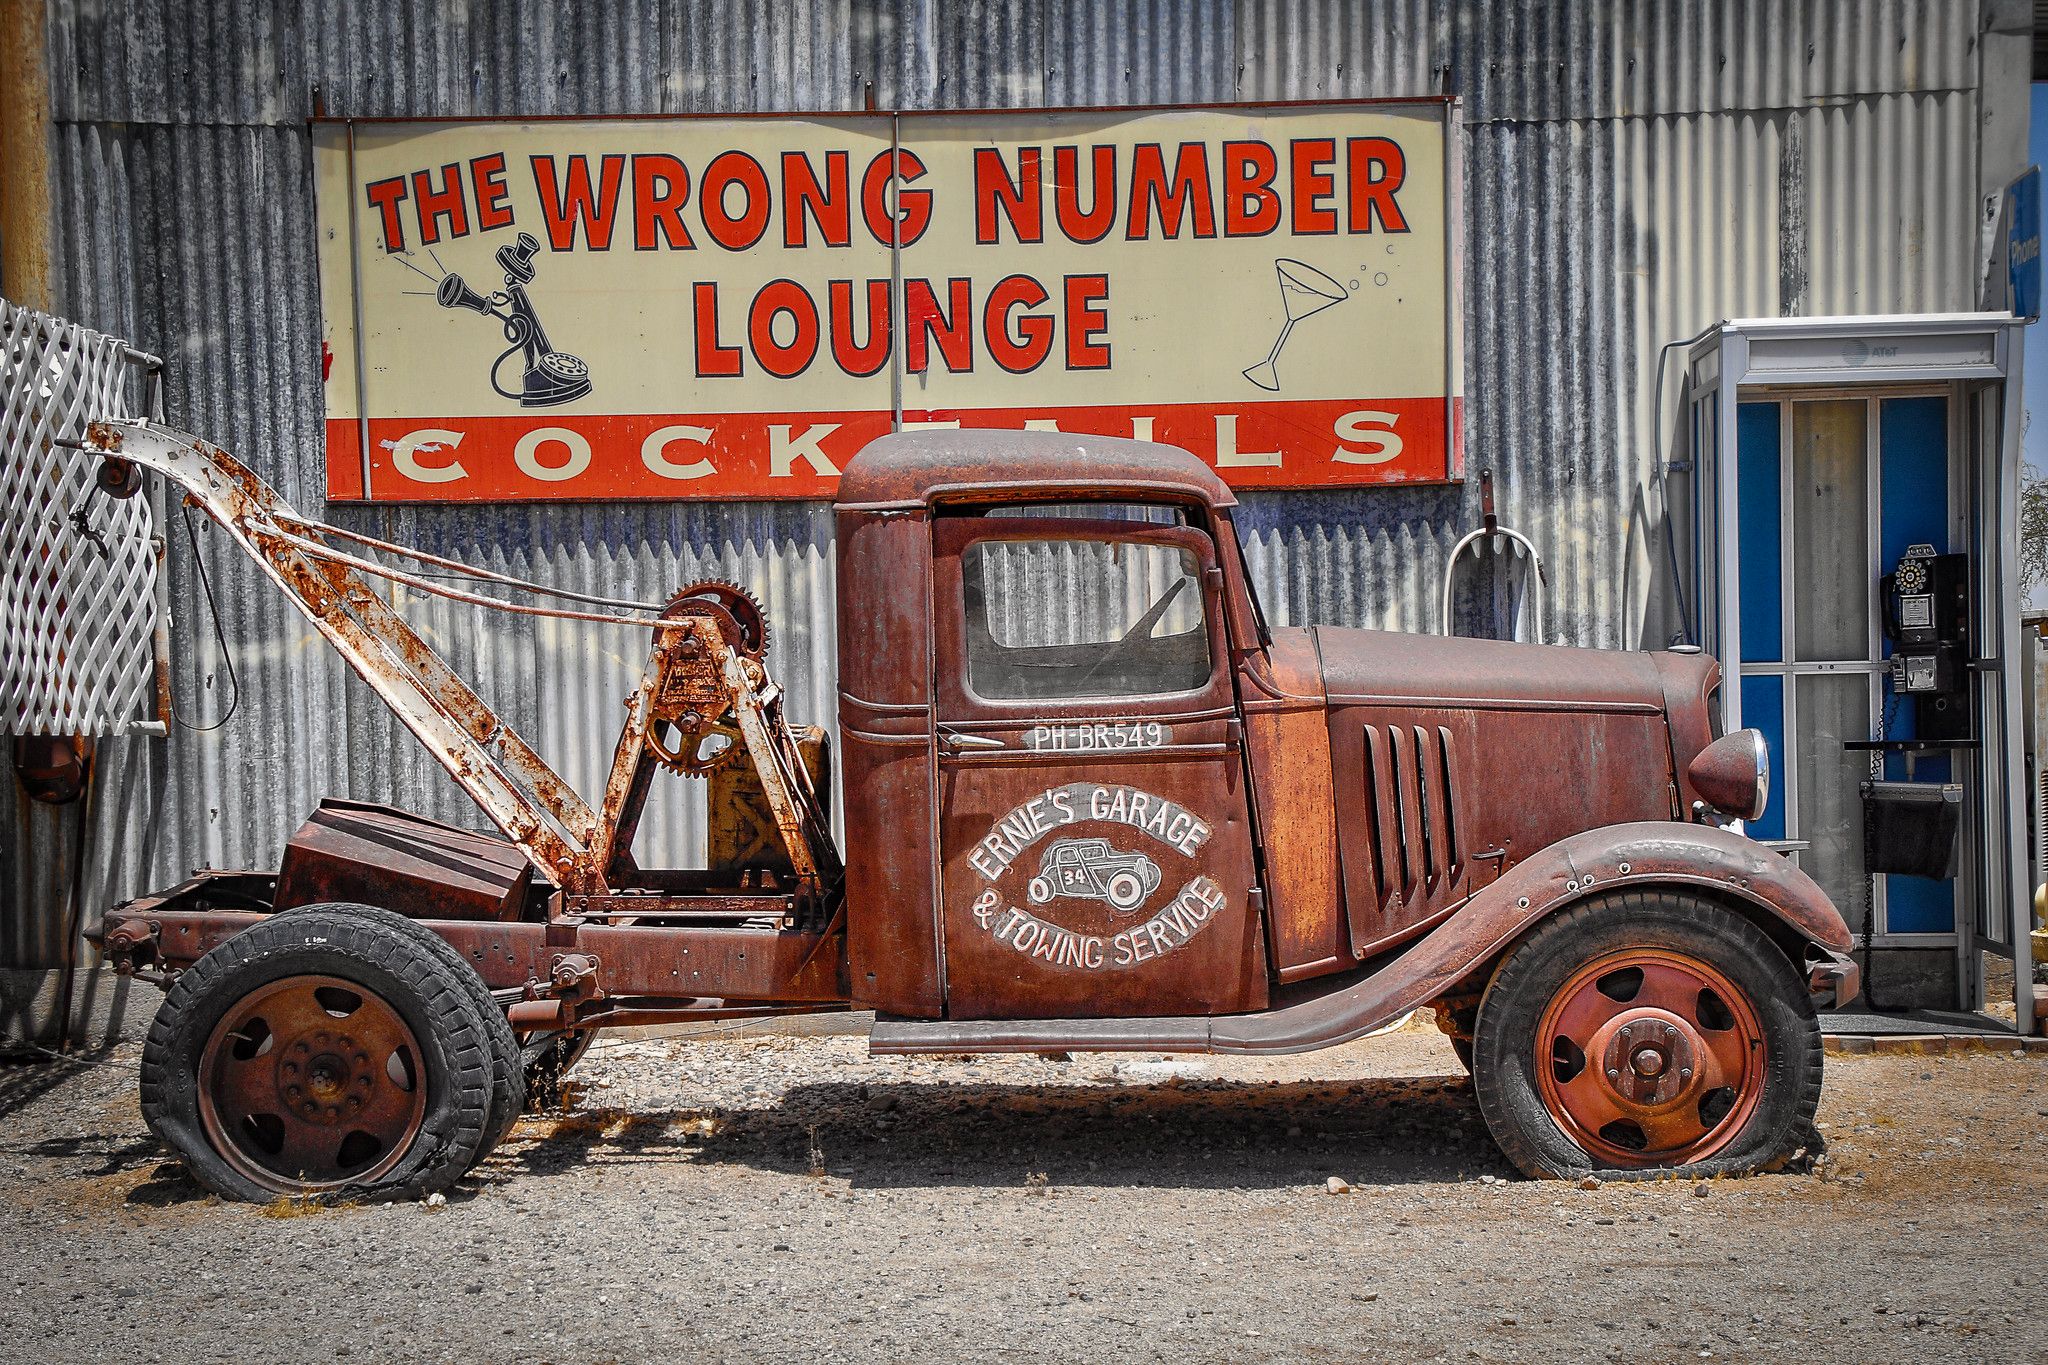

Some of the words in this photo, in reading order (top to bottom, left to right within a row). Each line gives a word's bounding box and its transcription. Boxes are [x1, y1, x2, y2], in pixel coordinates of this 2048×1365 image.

[366, 152, 516, 254] THE
[529, 147, 934, 252] WRONG
[973, 136, 1412, 245] NUMBER
[692, 272, 1113, 378] LOUNGE
[1033, 721, 1164, 750] PH-BR-549
[970, 789, 1075, 881] ERNIE'S
[1090, 787, 1212, 859] GARAGE
[1063, 868, 1087, 886] 34
[972, 890, 999, 931] &
[999, 906, 1104, 969] TOWING
[1114, 877, 1225, 966] SERVICE
